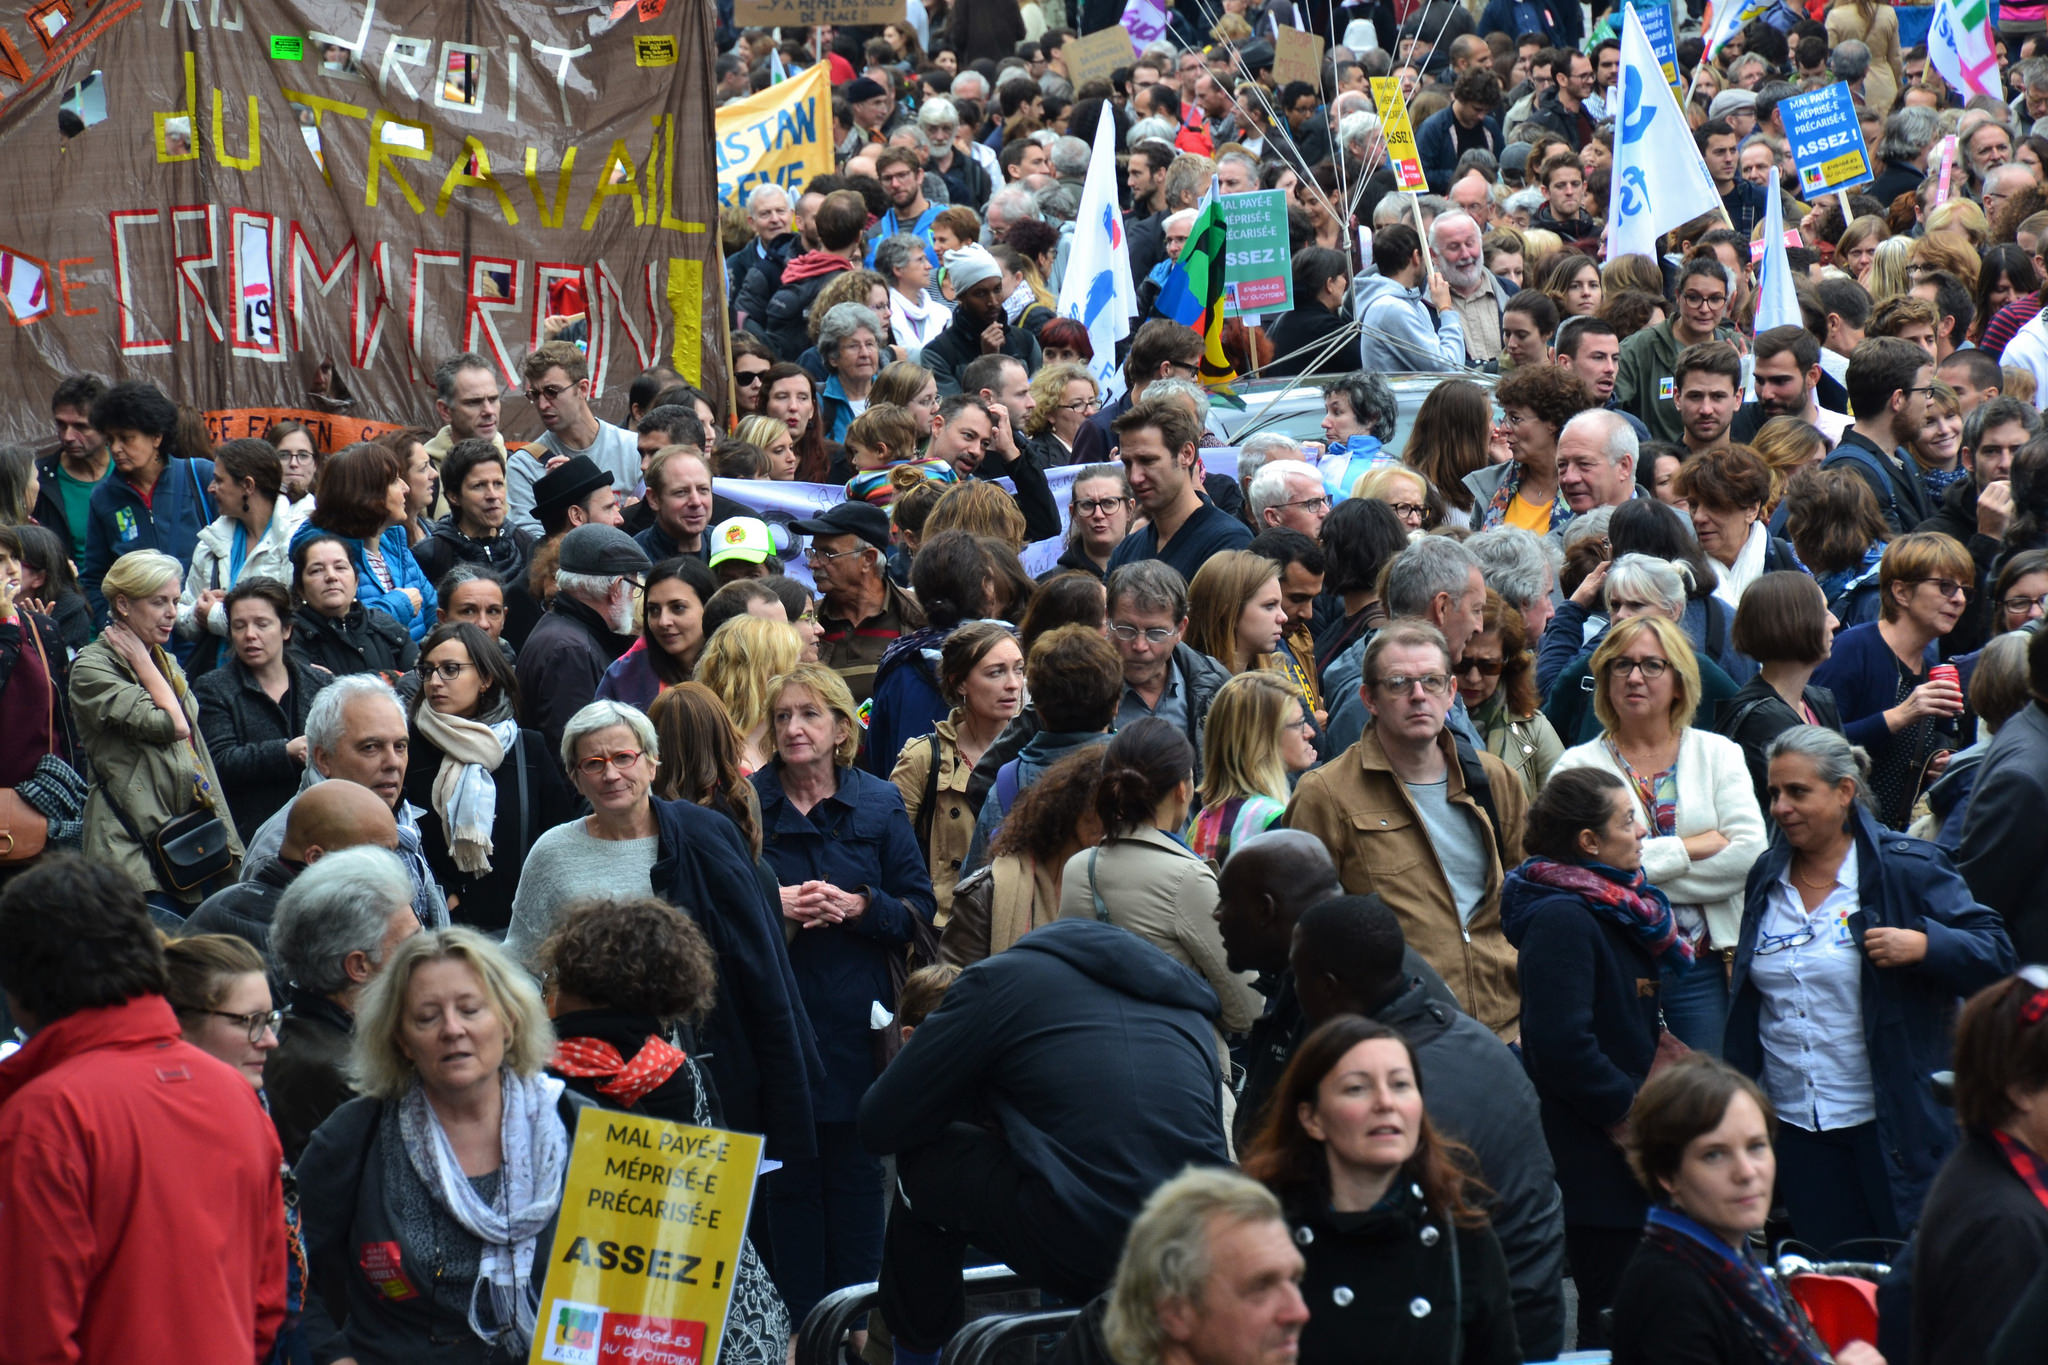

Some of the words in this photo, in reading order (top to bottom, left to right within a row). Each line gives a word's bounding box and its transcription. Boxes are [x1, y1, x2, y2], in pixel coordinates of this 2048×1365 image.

[1809, 87, 1838, 104] PAYÉ-E
[1795, 101, 1840, 122] MÉPRISÉ-E
[1795, 112, 1847, 136] PRÉCARISÉ-E
[1797, 132, 1850, 158] ASSEZ
[281, 87, 705, 232] TRAVAIL
[1240, 195, 1273, 209] PAYÉ-E
[605, 1123, 652, 1150] MAL
[658, 1132, 731, 1163] PAYÉ-E
[604, 1157, 719, 1195] MÉPRISÉ-E
[587, 1188, 722, 1229] PRÉCARISÉ-E
[563, 1236, 702, 1286] ASSEZ
[711, 1260, 725, 1289] !
[614, 1325, 691, 1348] ENGAGÉ-ES
[602, 1343, 620, 1354] AU
[623, 1346, 697, 1365] QUOTIDIEN
